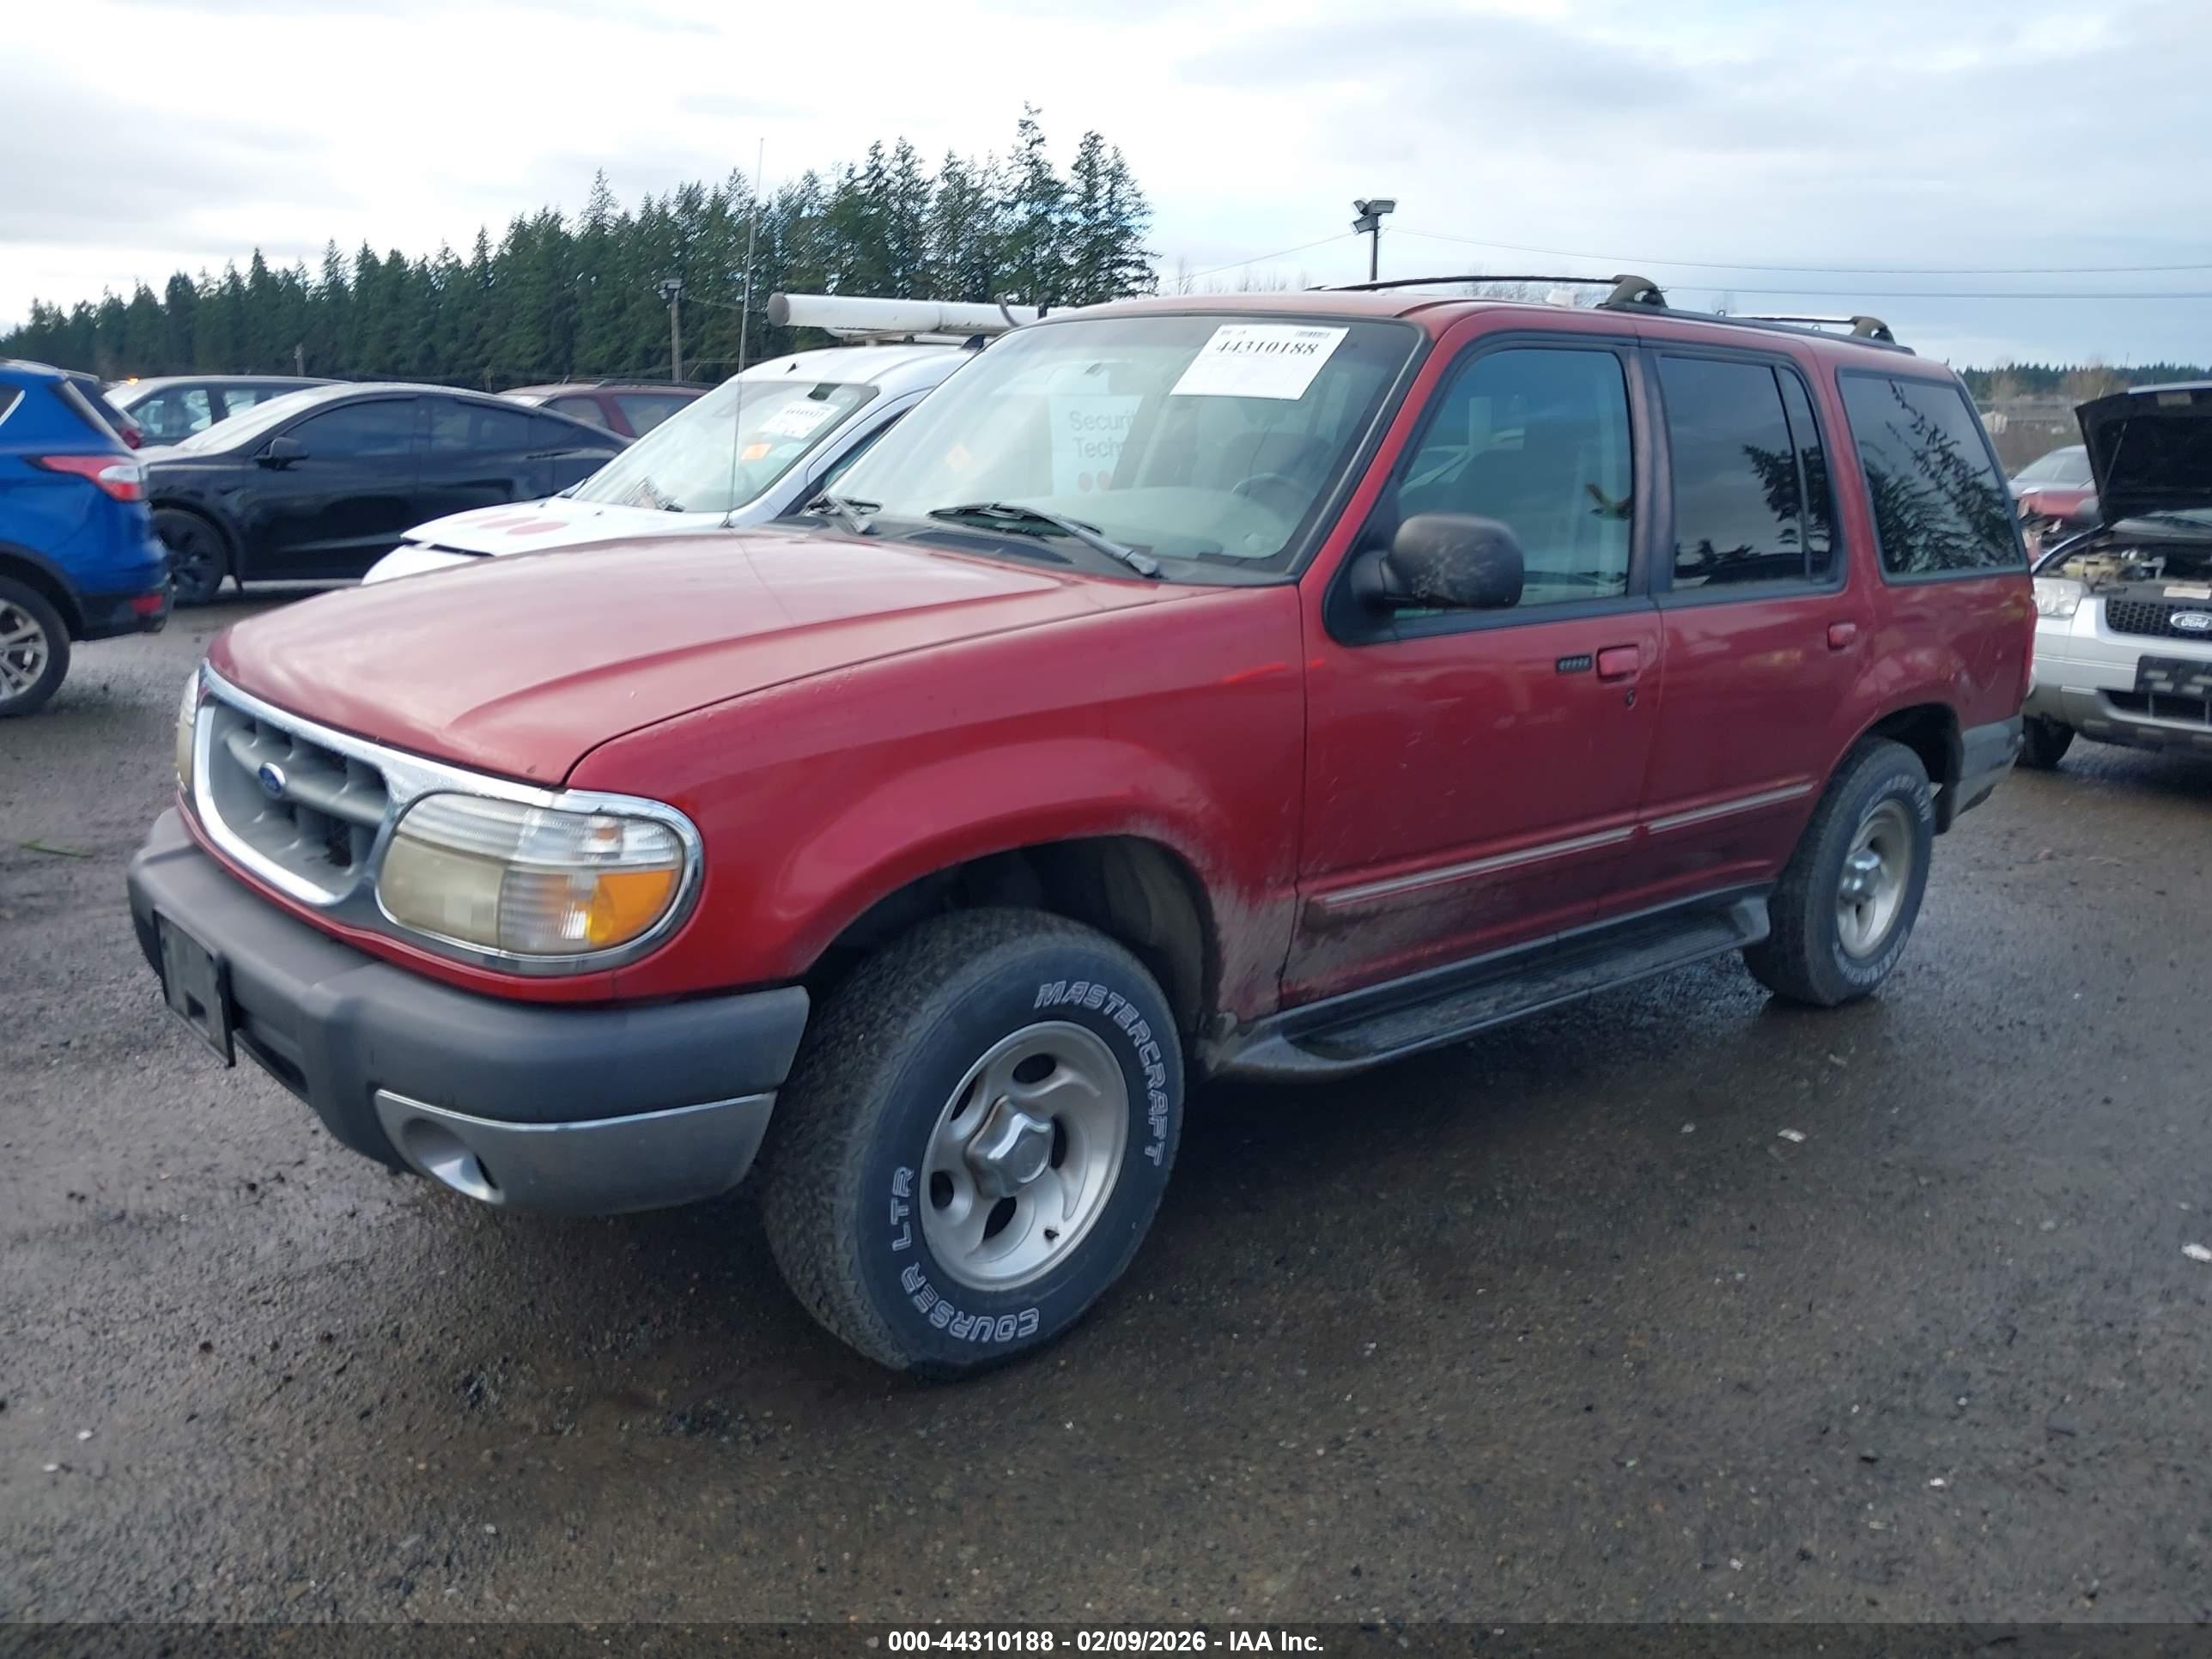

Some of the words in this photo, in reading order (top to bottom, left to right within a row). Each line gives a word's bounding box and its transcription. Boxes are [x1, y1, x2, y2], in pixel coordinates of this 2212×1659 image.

[1216, 340, 1320, 356] 44310188
[1071, 435, 1123, 459] Tech
[1033, 980, 1169, 1166] MASTERCRAFT
[890, 1166, 915, 1252] LTR
[901, 1261, 1040, 1343] COURSER
